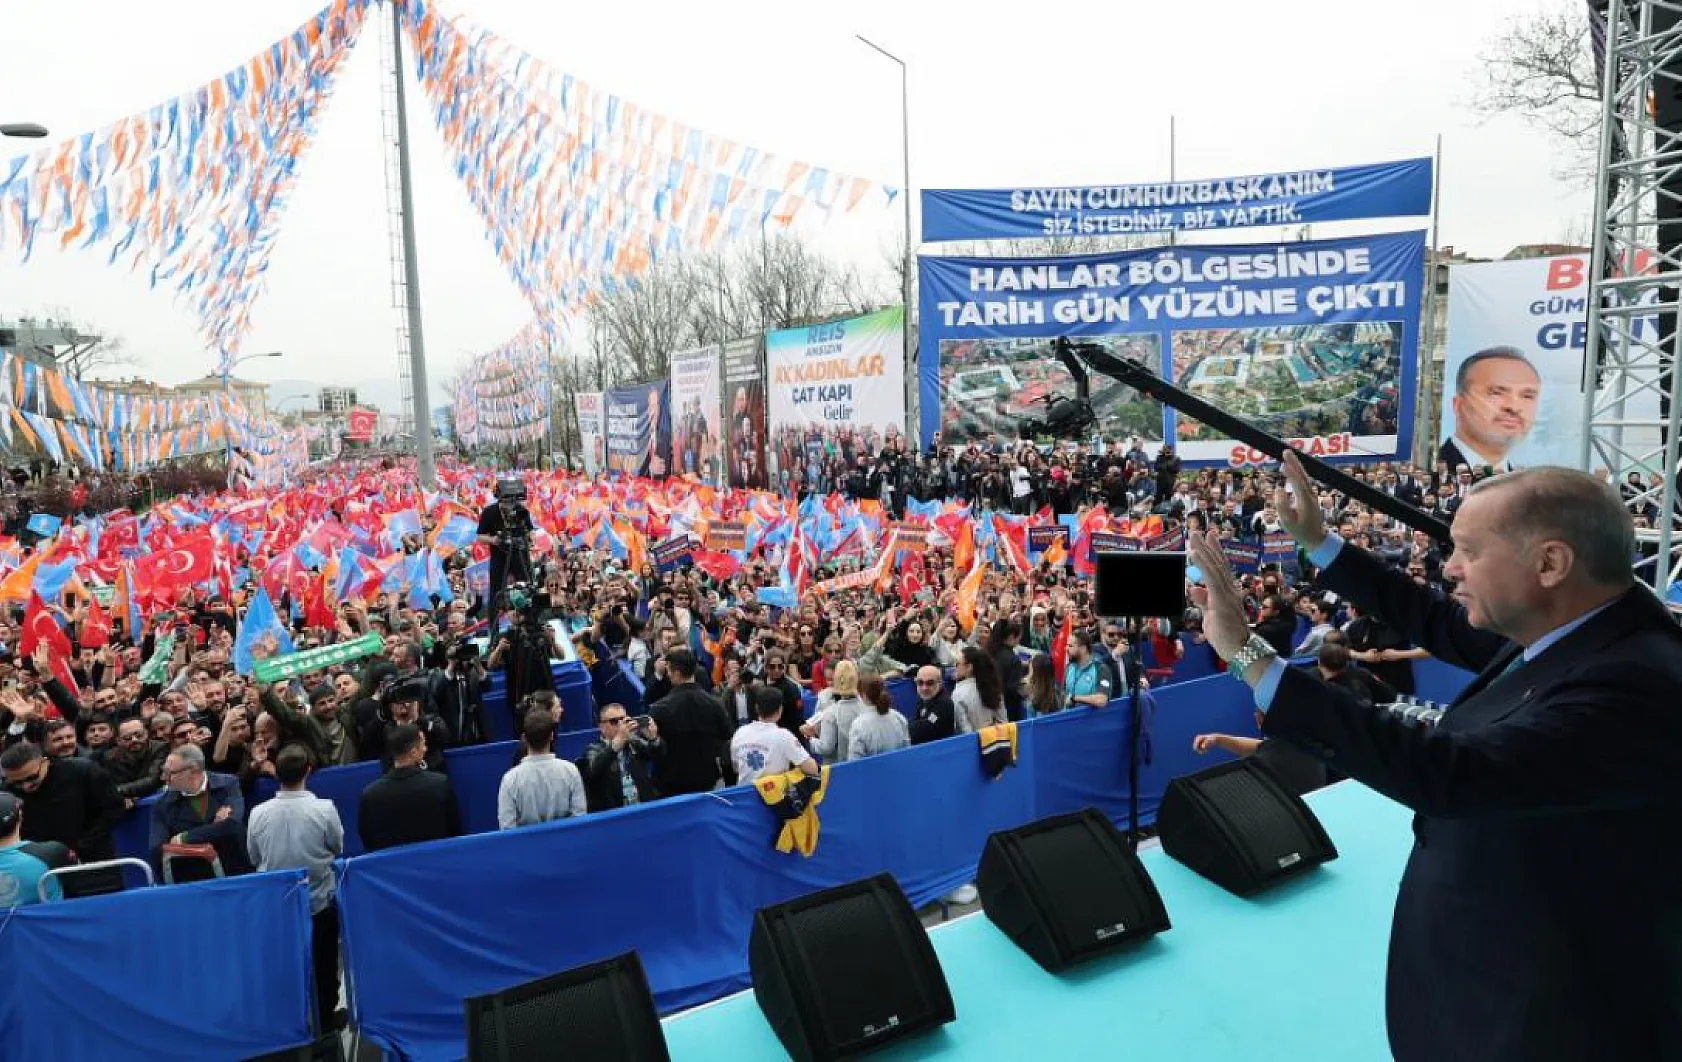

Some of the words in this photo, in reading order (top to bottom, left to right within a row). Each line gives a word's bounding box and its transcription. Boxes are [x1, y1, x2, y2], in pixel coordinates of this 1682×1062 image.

[1011, 188, 1083, 212] SAYIN
[1088, 171, 1335, 210] CUMHURBAŞKANIM
[1043, 211, 1073, 235] SİZ
[1184, 206, 1217, 229] BİZ
[969, 264, 1121, 292] HANLAR
[1128, 247, 1372, 286] BÖLGESİNDE
[937, 296, 1045, 326] TARİH
[1052, 293, 1130, 324] GÜN
[1139, 284, 1299, 320] YÜZÜNE
[1306, 281, 1406, 317] ÇIKTI
[794, 352, 886, 383] KADINLAR
[817, 383, 853, 402] KAPI
[824, 403, 854, 420] Gelir
